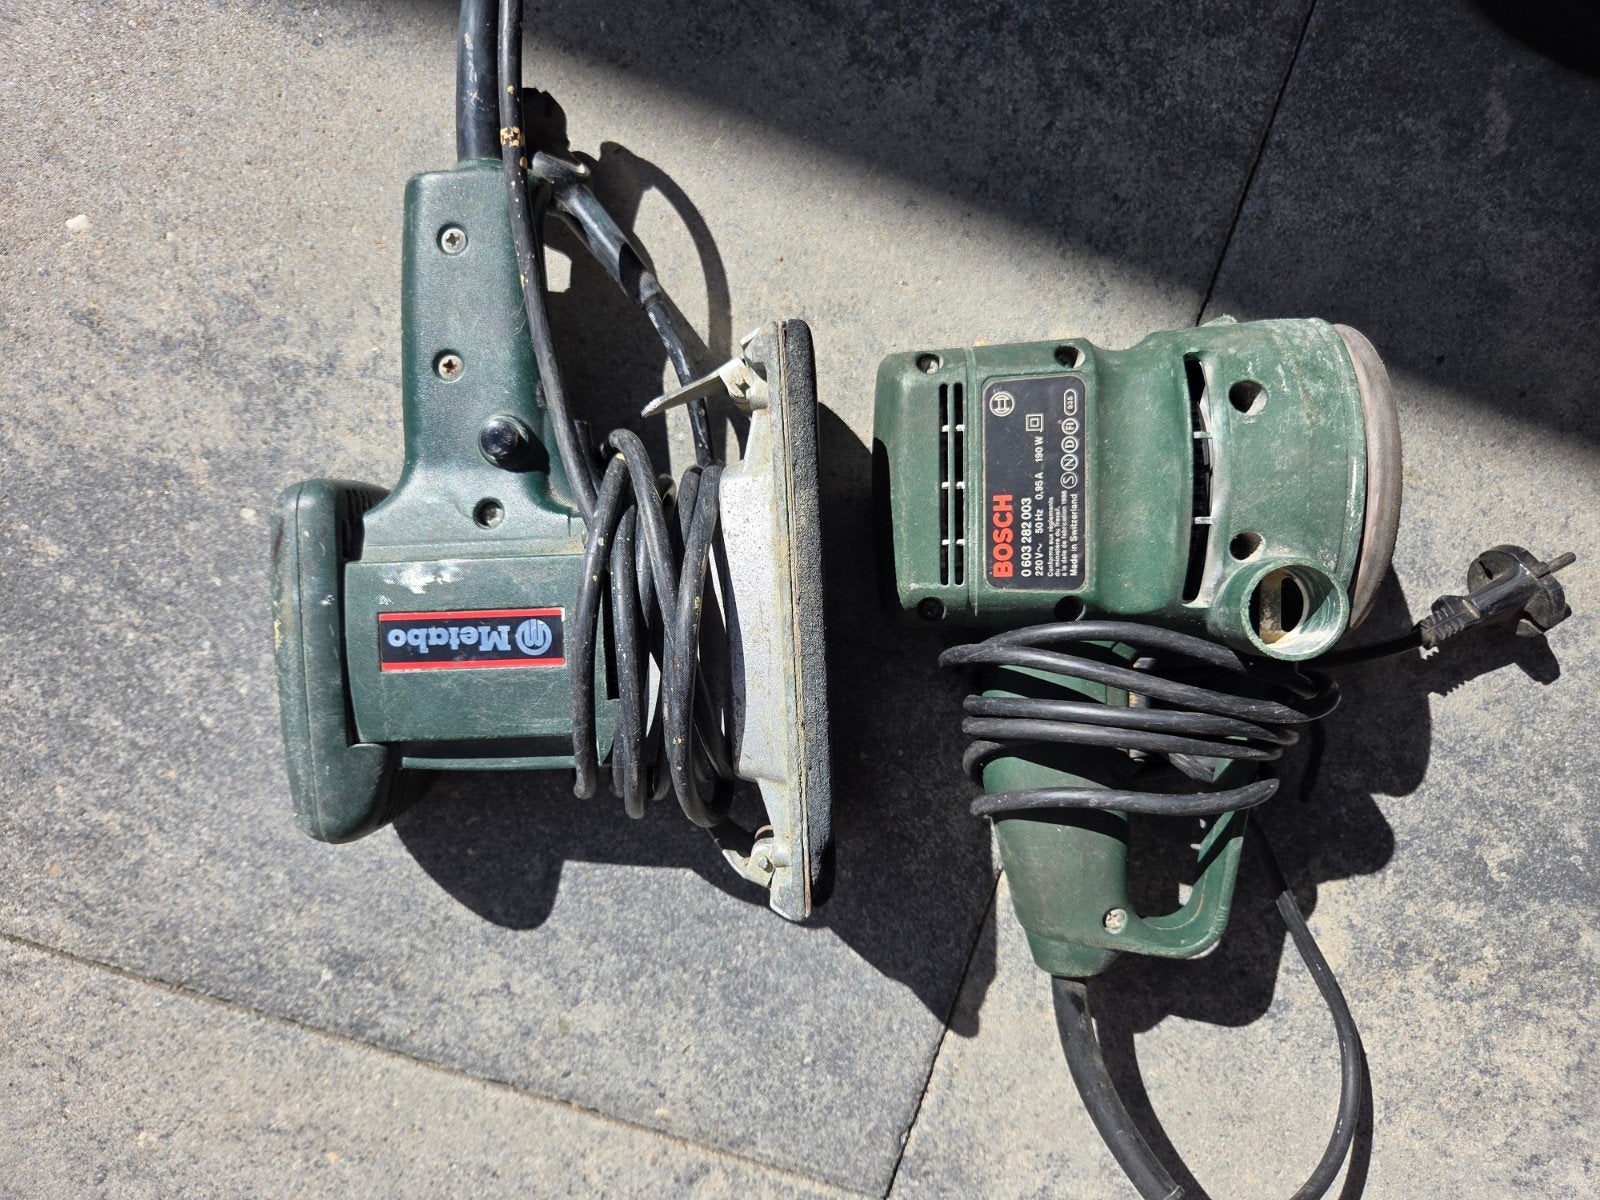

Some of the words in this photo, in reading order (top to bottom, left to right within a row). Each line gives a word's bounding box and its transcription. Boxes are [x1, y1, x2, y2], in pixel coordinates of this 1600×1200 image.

[1034, 436, 1044, 445] W
[1034, 447, 1044, 462] 190
[1021, 497, 1032, 520] 003
[1034, 508, 1044, 521] Hz
[1070, 494, 1078, 542] Switzerland
[992, 494, 1014, 577] BOSCH
[1021, 522, 1032, 544] 282
[1034, 522, 1044, 534] 50
[1070, 544, 1078, 552] in
[1021, 545, 1032, 568] 603
[1021, 569, 1032, 577] 0
[1034, 560, 1044, 576] 220
[1054, 568, 1060, 577] du
[1070, 554, 1078, 576] Made
[387, 626, 511, 654] Metabo
